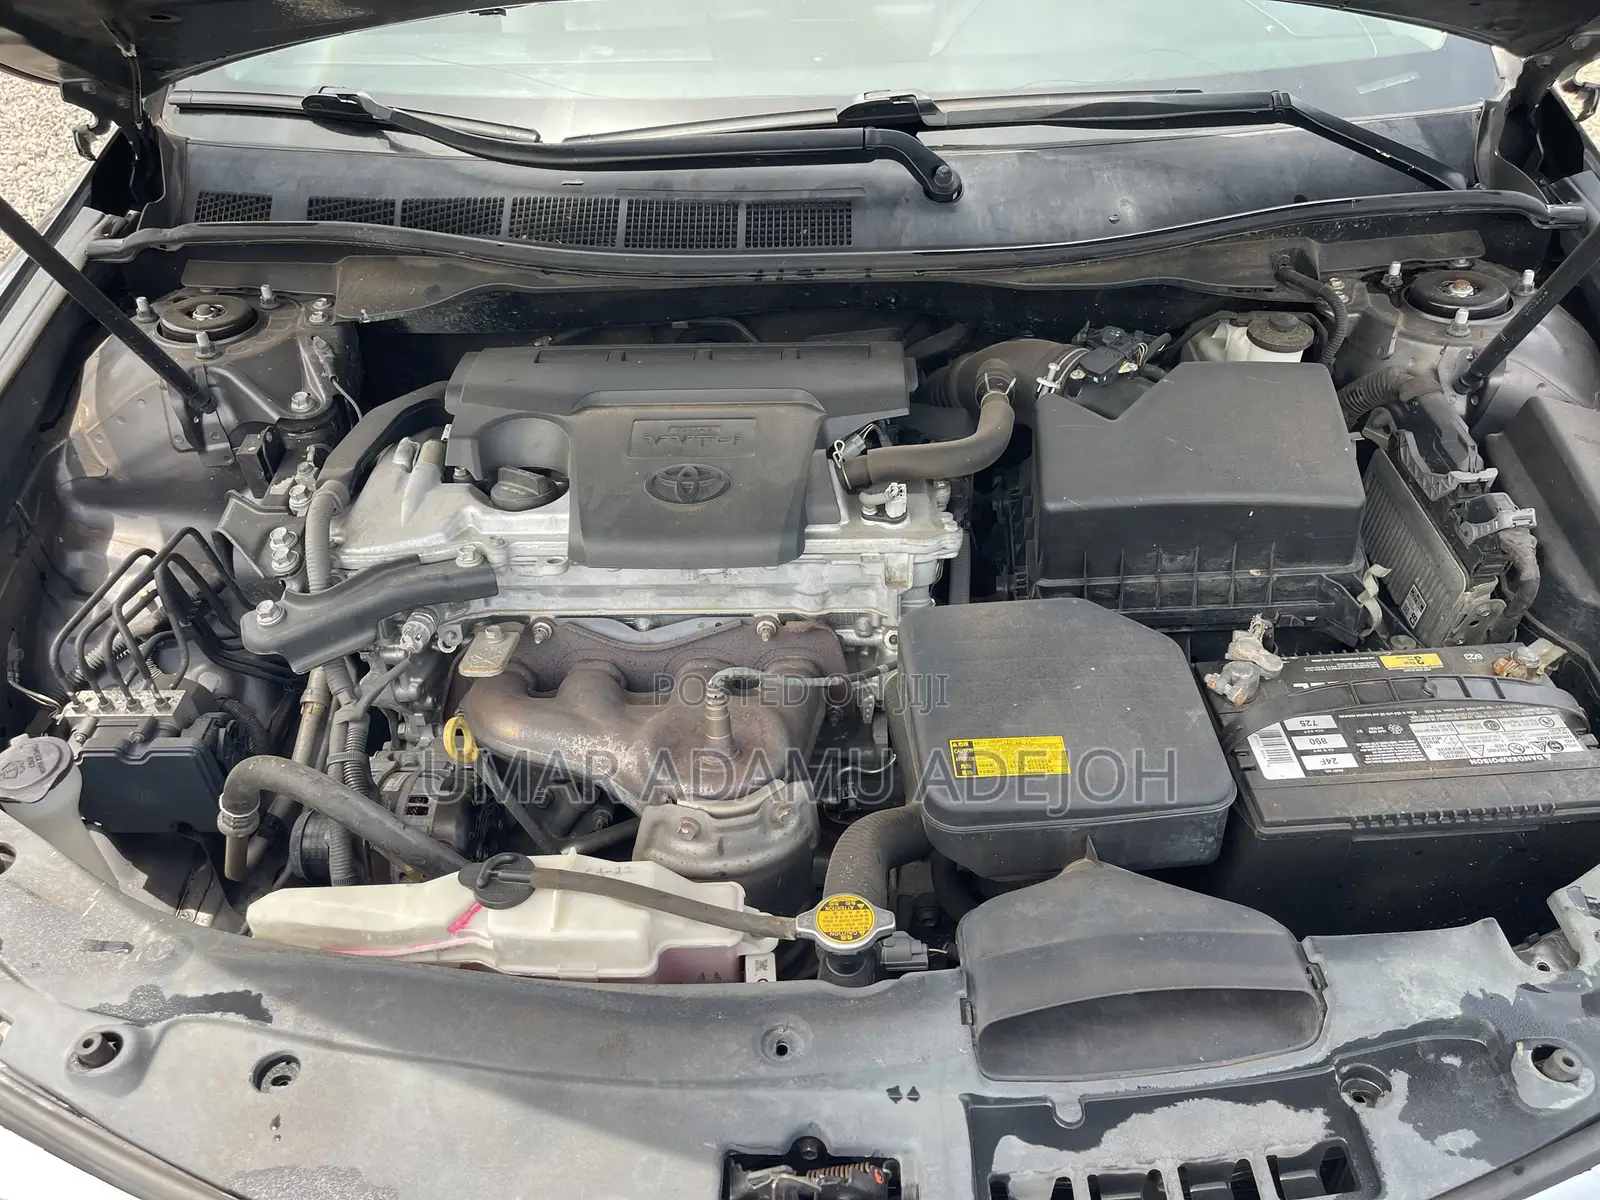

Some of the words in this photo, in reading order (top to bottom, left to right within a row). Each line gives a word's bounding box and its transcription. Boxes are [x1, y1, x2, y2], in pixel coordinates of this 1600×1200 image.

[1413, 656, 1424, 665] 3
[1309, 738, 1328, 746] 890
[1320, 758, 1339, 766] 24F
[1469, 754, 1545, 765] DANGER/POISON
